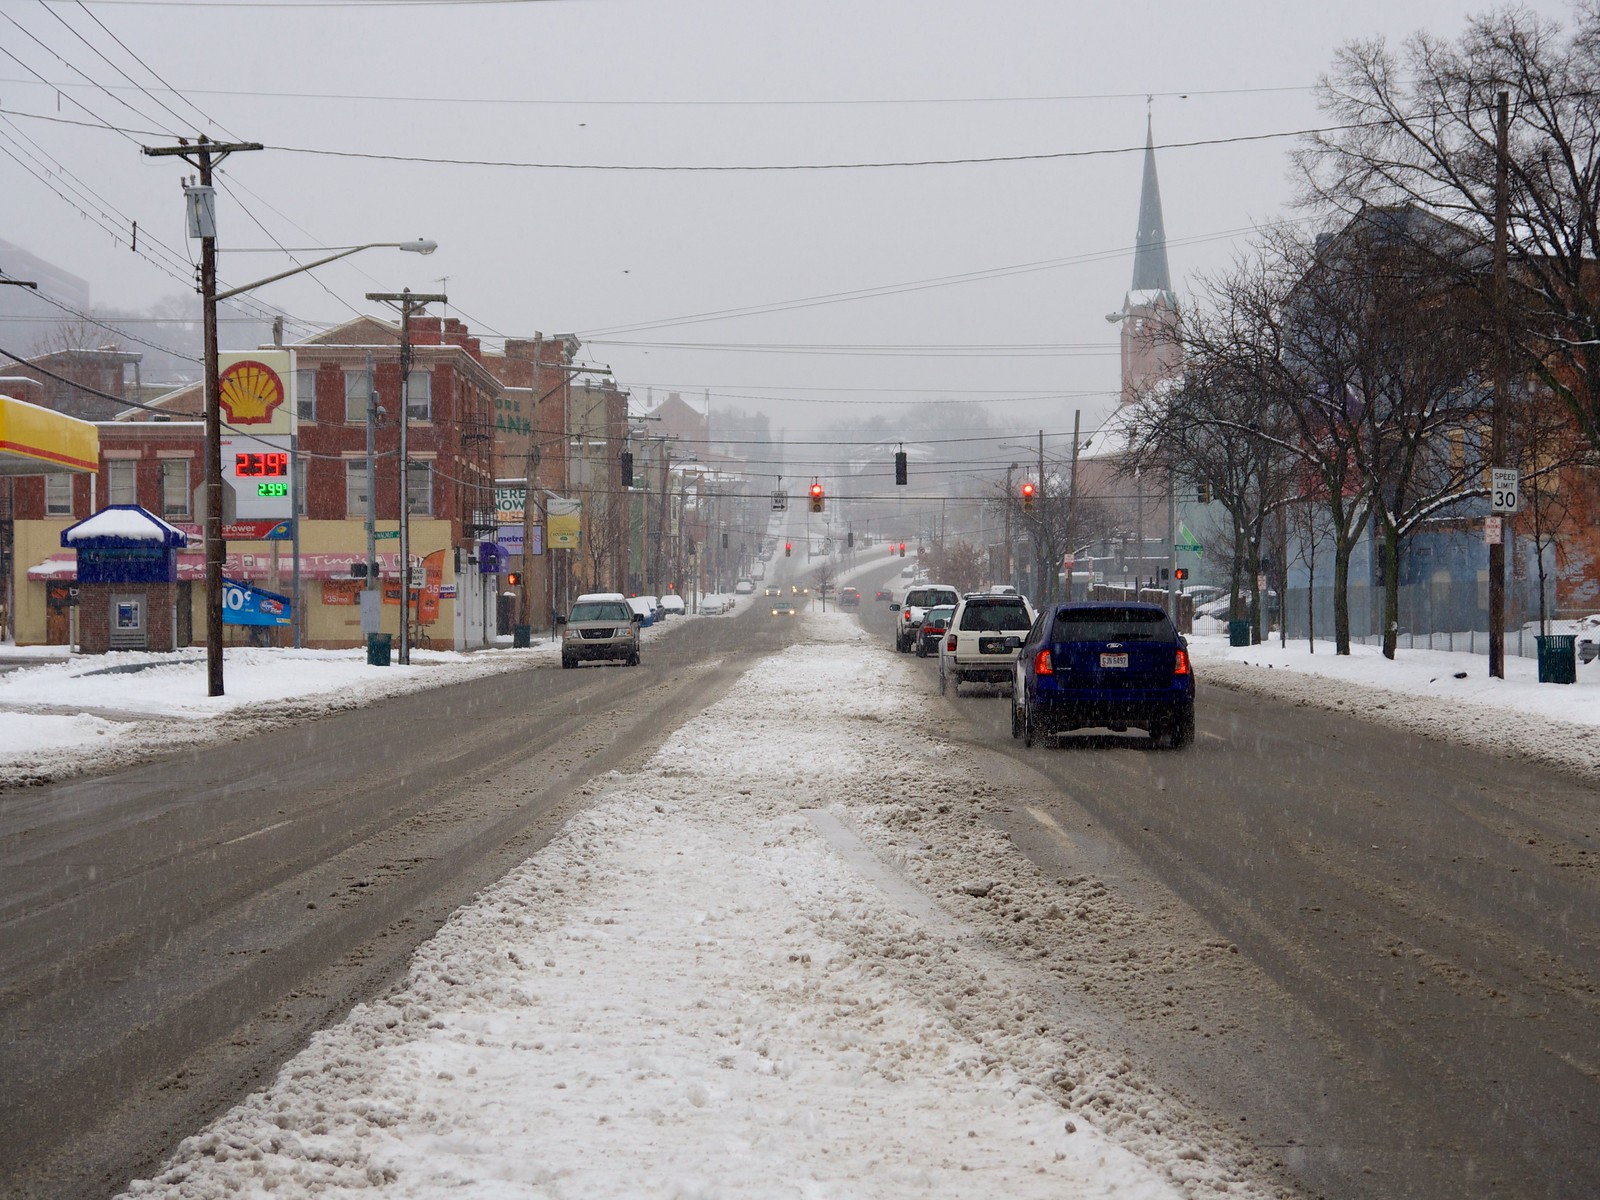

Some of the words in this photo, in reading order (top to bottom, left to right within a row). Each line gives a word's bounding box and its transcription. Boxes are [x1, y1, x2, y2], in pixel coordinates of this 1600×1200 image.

[1494, 472, 1516, 481] SPEED
[1494, 491, 1516, 507] 30
[310, 555, 368, 565] Tina's
